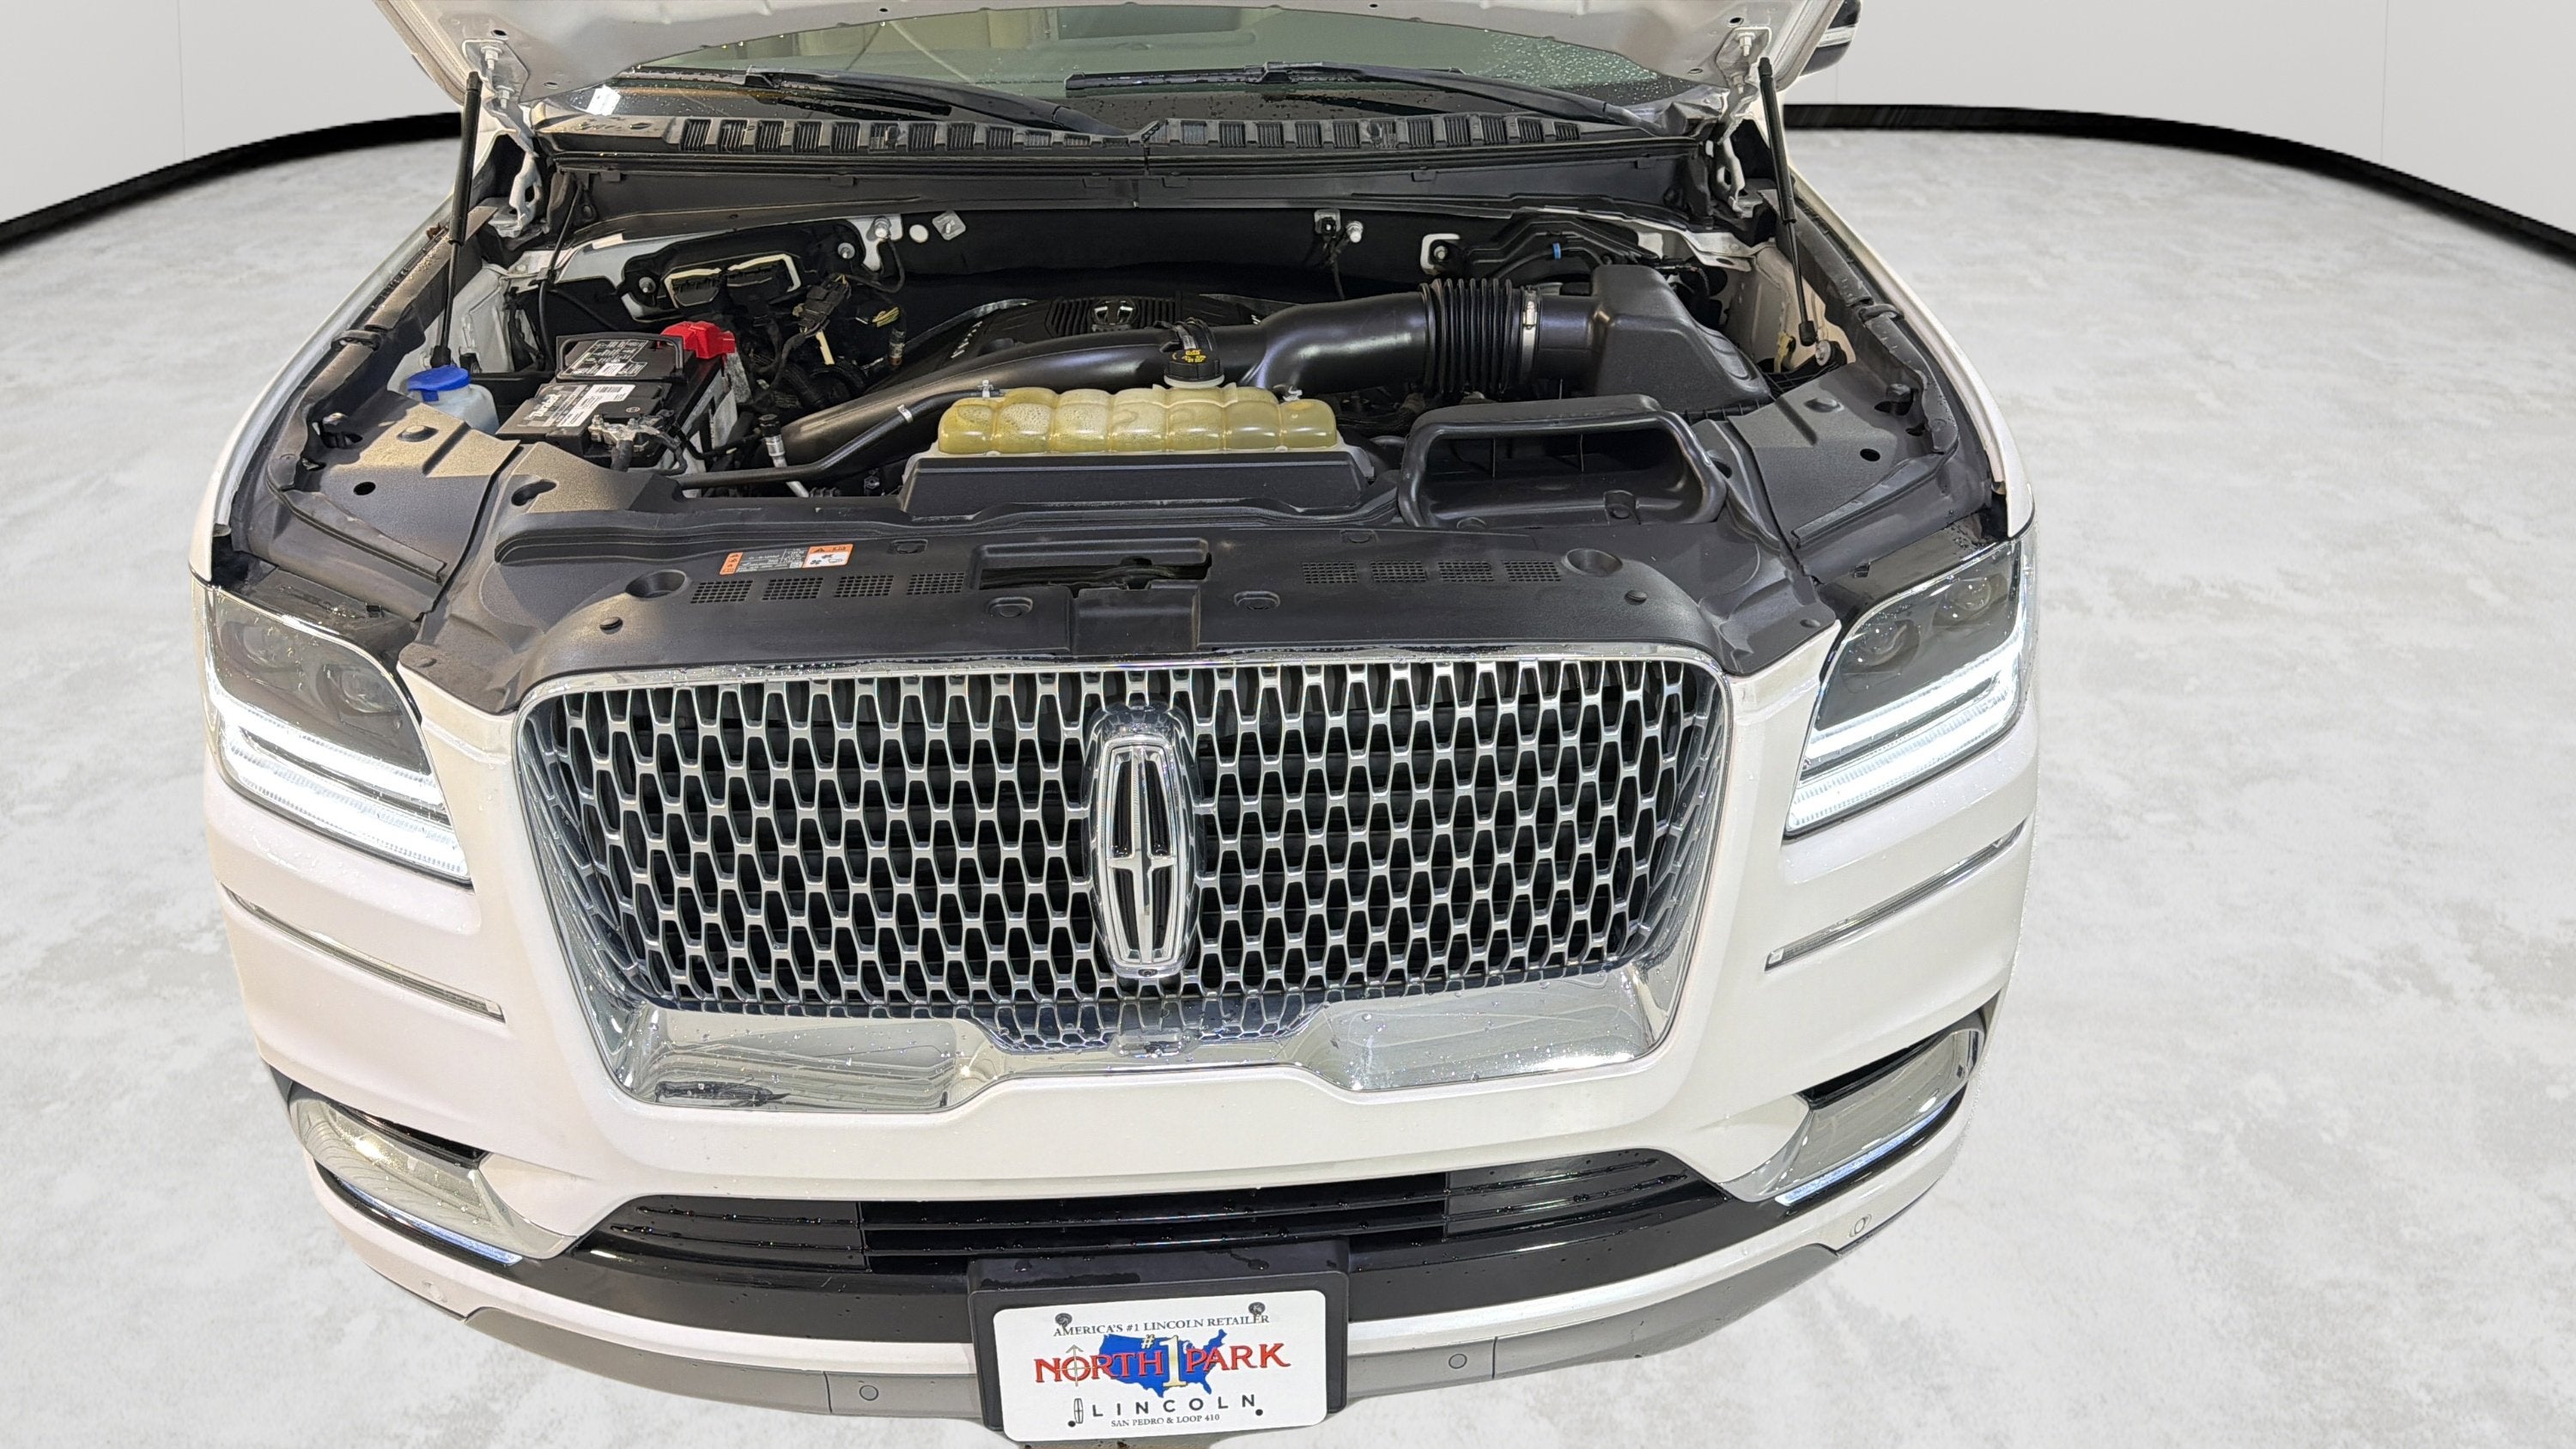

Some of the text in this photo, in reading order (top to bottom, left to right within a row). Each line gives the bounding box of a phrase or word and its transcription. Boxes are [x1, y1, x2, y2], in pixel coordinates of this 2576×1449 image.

[1053, 1314, 1270, 1336] AMERICA'S #1 LINCOLN RETAILER
[1033, 1343, 1291, 1384] NORTH PARK
[1092, 1394, 1255, 1417] LINCOLN
[1111, 1419, 1130, 1428] SAN
[1133, 1416, 1164, 1427] PEDRO
[1176, 1415, 1202, 1424] LOOP
[1205, 1413, 1220, 1422] 410
